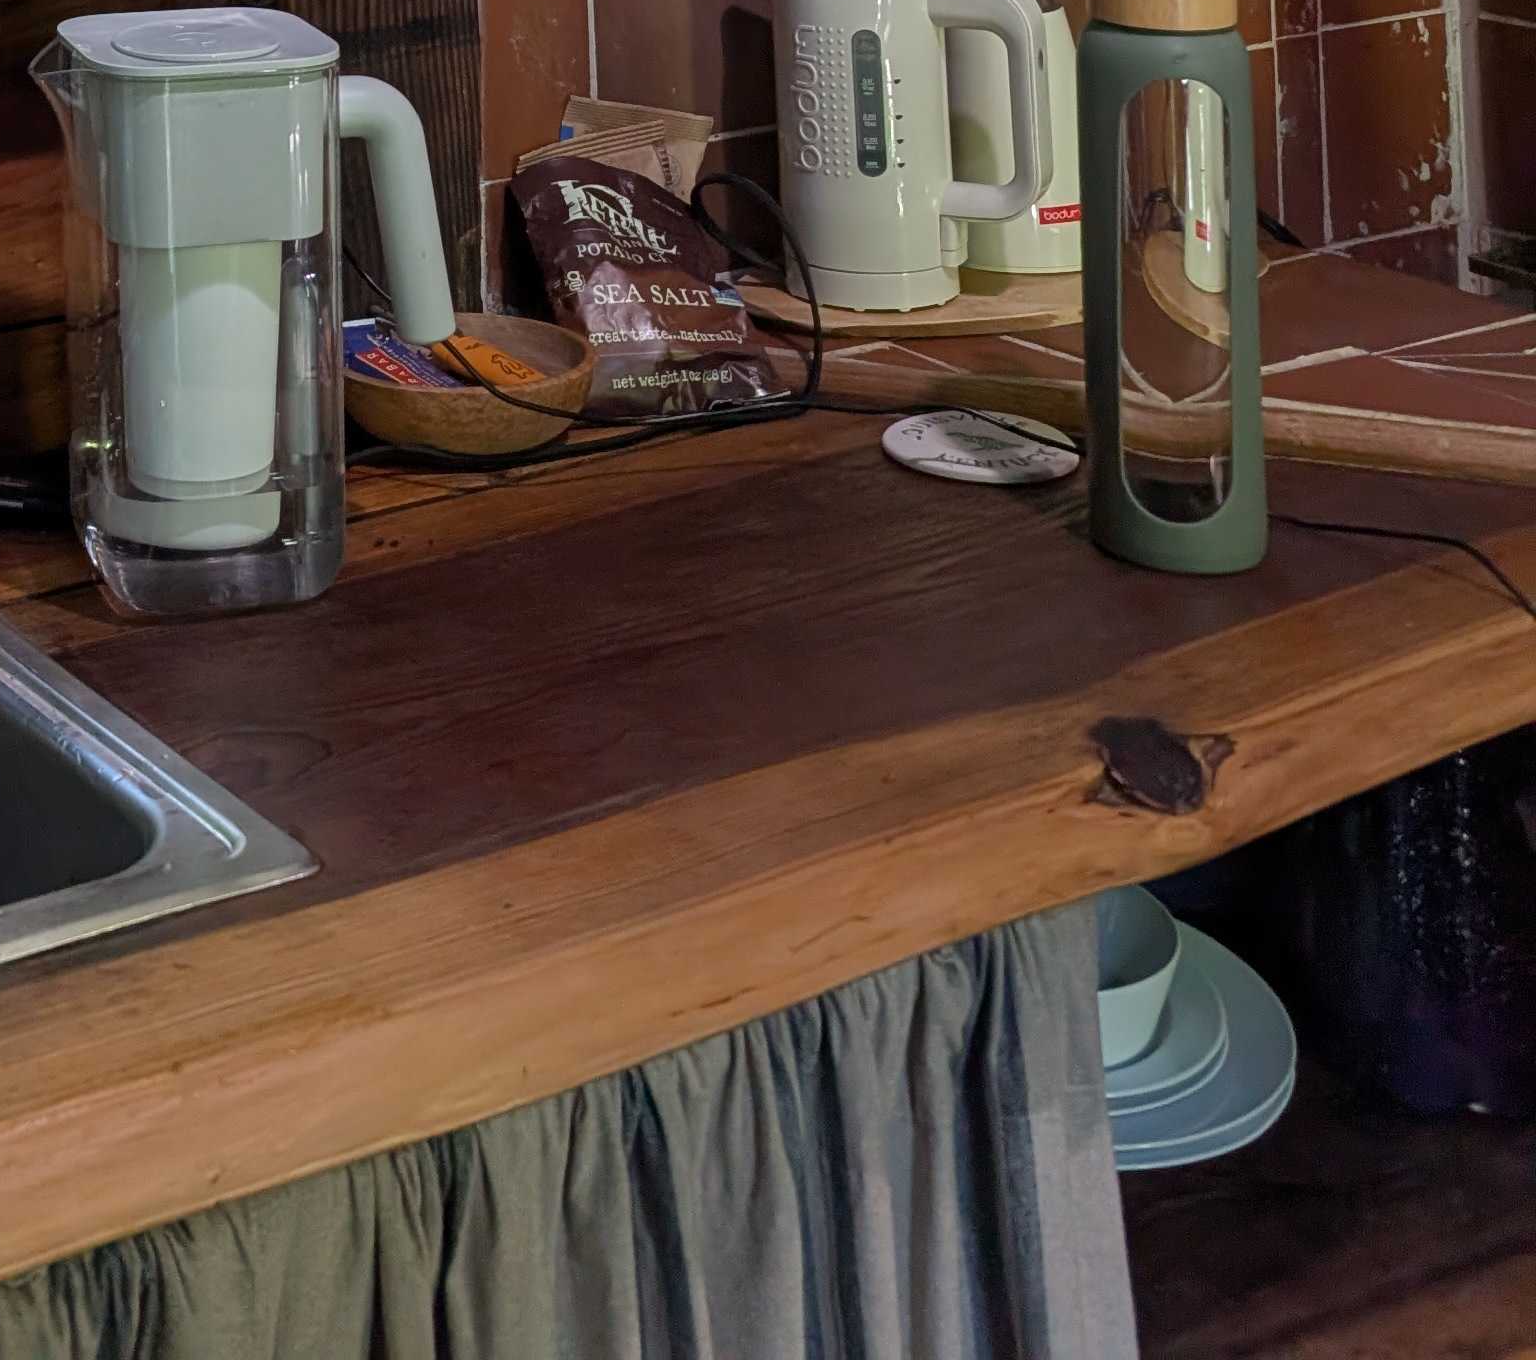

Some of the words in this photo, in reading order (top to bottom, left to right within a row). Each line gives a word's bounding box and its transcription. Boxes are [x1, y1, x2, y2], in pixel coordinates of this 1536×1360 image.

[791, 24, 823, 171] bodum
[592, 283, 646, 305] SEA
[650, 284, 711, 307] SALT
[588, 327, 628, 346] great
[612, 374, 637, 390] net
[638, 369, 680, 389] weight
